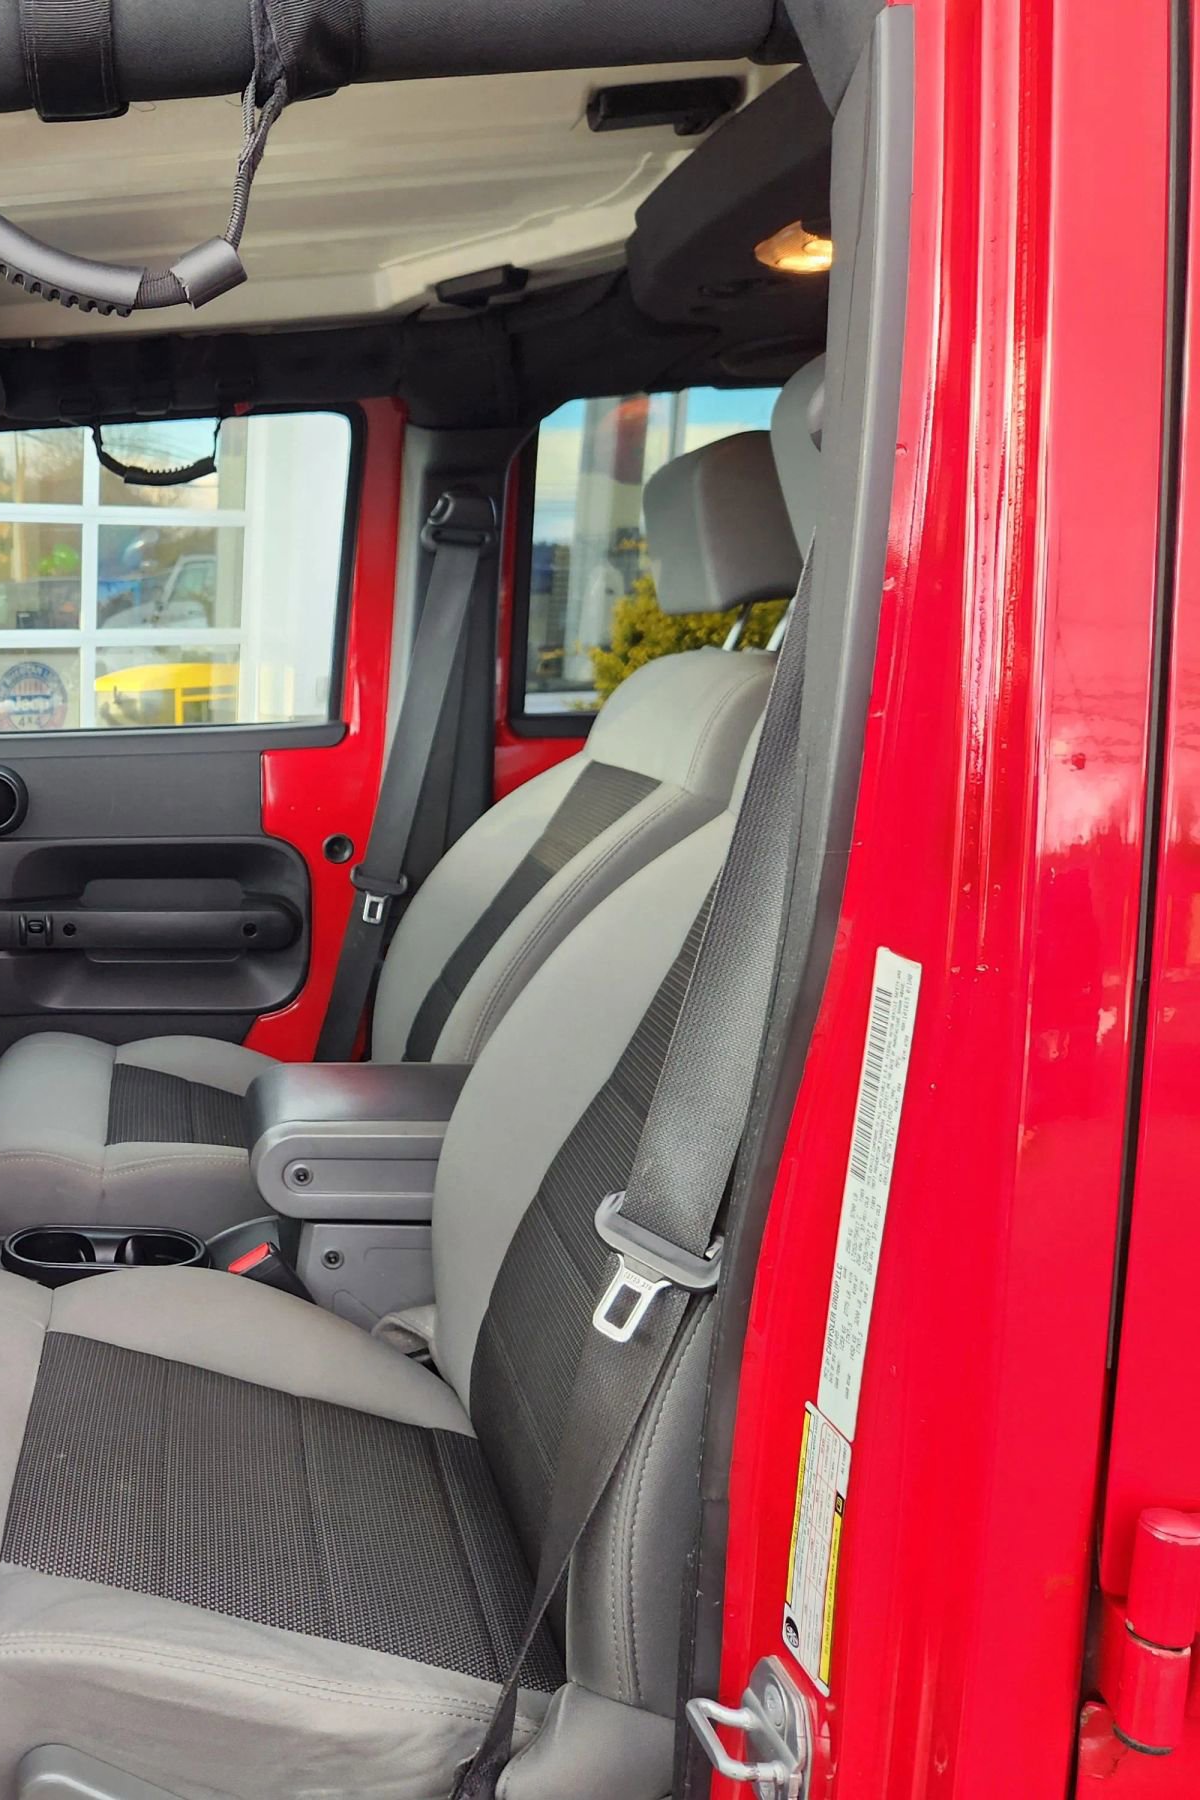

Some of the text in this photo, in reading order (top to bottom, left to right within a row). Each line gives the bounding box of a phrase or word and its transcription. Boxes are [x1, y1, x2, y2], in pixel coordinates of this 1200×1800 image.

[834, 1260, 843, 1281] LLC
[830, 1278, 840, 1312] GROUP
[825, 1308, 837, 1357] CHRYSLER
